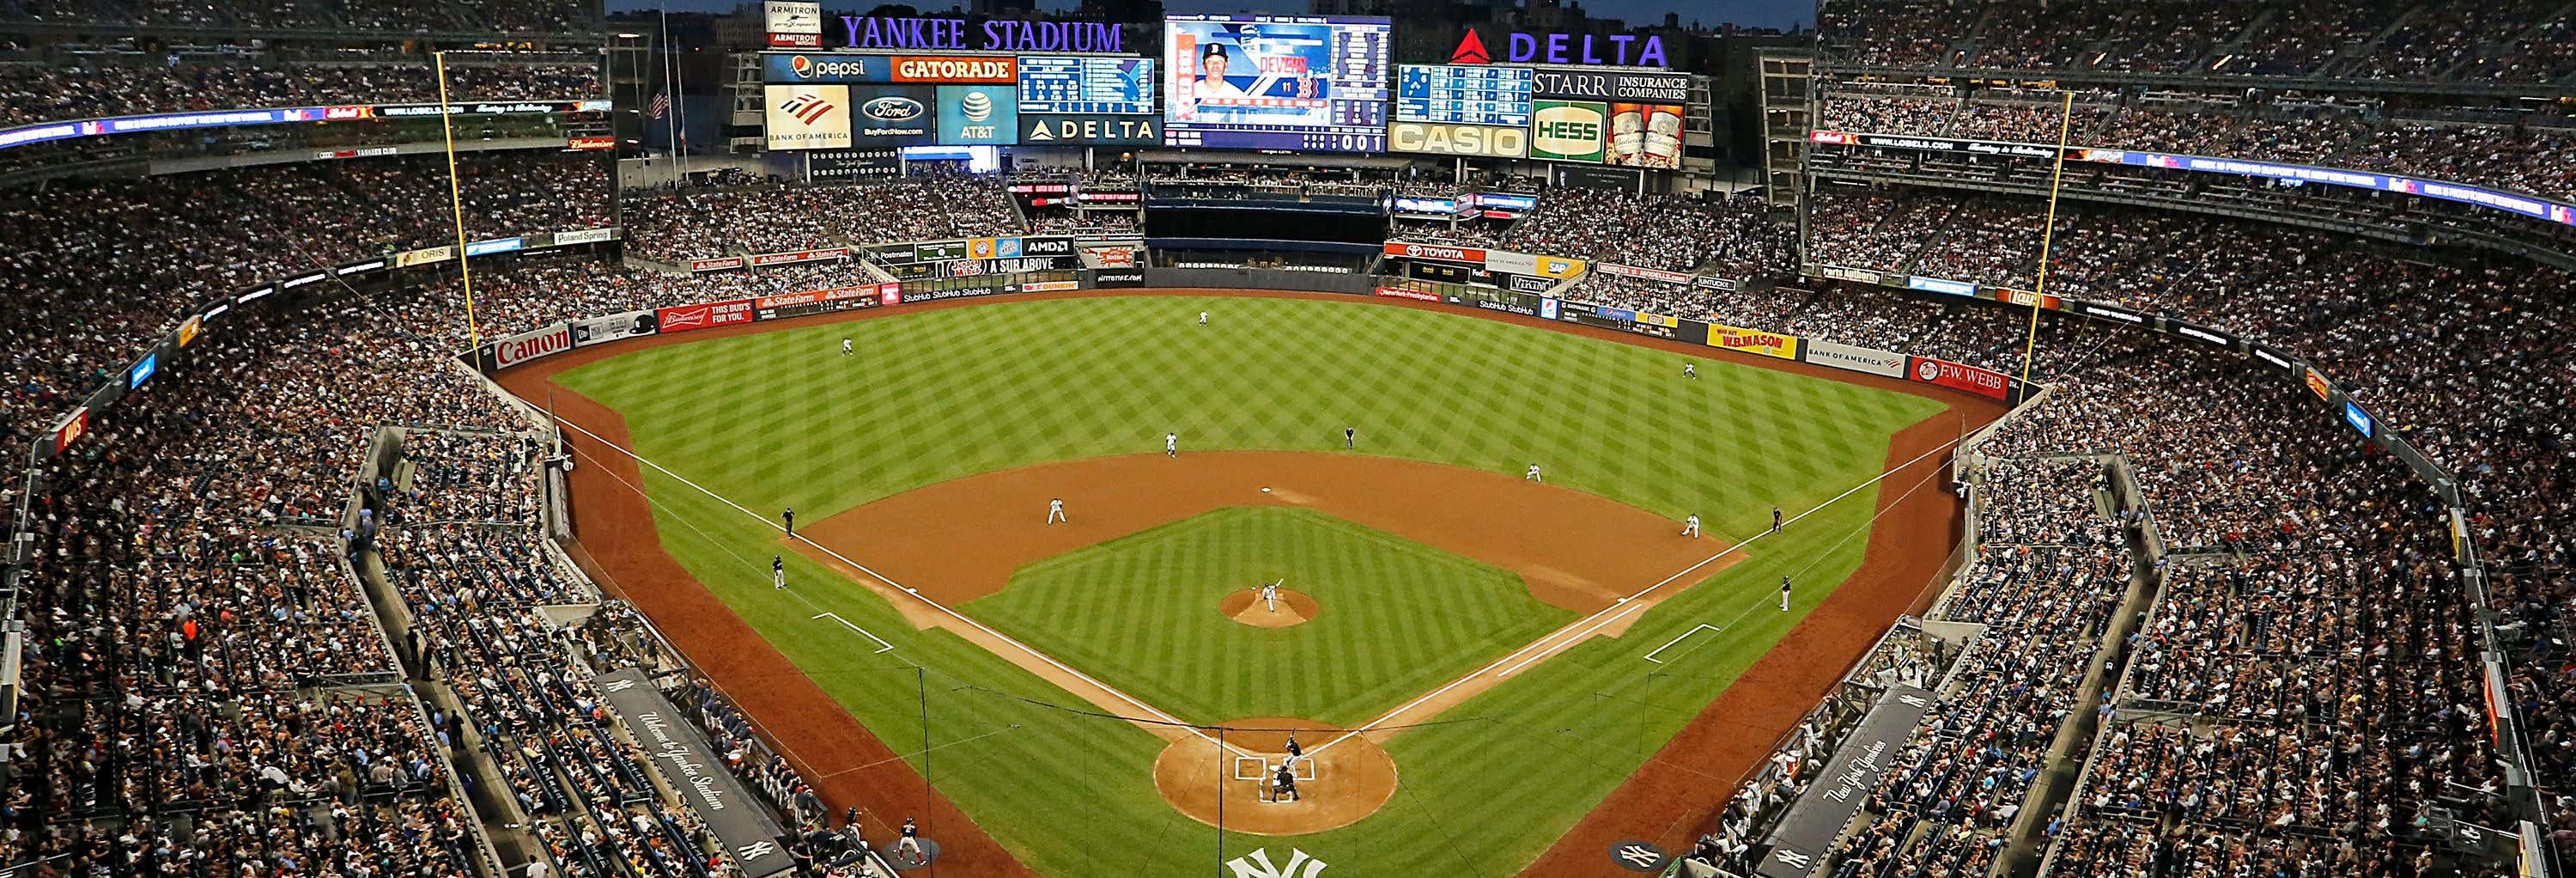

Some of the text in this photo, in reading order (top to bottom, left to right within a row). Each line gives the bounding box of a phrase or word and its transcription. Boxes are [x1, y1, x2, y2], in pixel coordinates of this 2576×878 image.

[771, 6, 817, 15] ARMITRON
[841, 15, 1122, 52] YANKEE STADIUM
[1509, 32, 1668, 68] DELTA
[815, 58, 865, 78] pepsi
[899, 61, 1010, 79] GATORADE
[1283, 82, 1291, 92] 11
[1533, 74, 1687, 96] STARR INSURANCE
[1618, 87, 1686, 100] COMPANIES
[874, 101, 911, 118] Ford
[864, 128, 923, 137] BuyFordNow.com
[961, 125, 995, 139] AT&T
[1061, 120, 1154, 139] DELTA
[1538, 120, 1598, 141] HESS
[569, 138, 615, 149] Budweiser
[1394, 125, 1525, 157] CASIO
[1870, 137, 1953, 150] WWW.LOBELS.COM
[558, 231, 609, 244] Poland Spring
[422, 249, 445, 259] ORIS
[1028, 241, 1057, 253] AMD
[1422, 247, 1465, 259] TOYOTA
[880, 251, 914, 259] Postmates
[990, 257, 1054, 274] A SUB ABOVE
[1548, 262, 1566, 273] SAP
[1472, 268, 1492, 278] FedEx
[1639, 270, 1686, 283] MODELLS.com
[1823, 266, 1880, 283] Parts Authority
[1513, 277, 1552, 291] VIKING
[904, 288, 991, 302] StubHub StubHub StubHub
[729, 303, 750, 312] BUD'S
[1479, 300, 1534, 315] StubHub StubHub
[712, 315, 726, 324] FOR
[497, 329, 569, 365] Canon
[1808, 348, 1831, 358] BANK
[1844, 353, 1881, 366] AMERICA
[1940, 364, 2002, 390] F.W. WEBB
[638, 710, 670, 745] Welcome
[656, 746, 702, 778] Yankee
[690, 775, 726, 812] Stadium
[1822, 784, 1853, 804] New
[1852, 740, 1887, 772] Yankees
